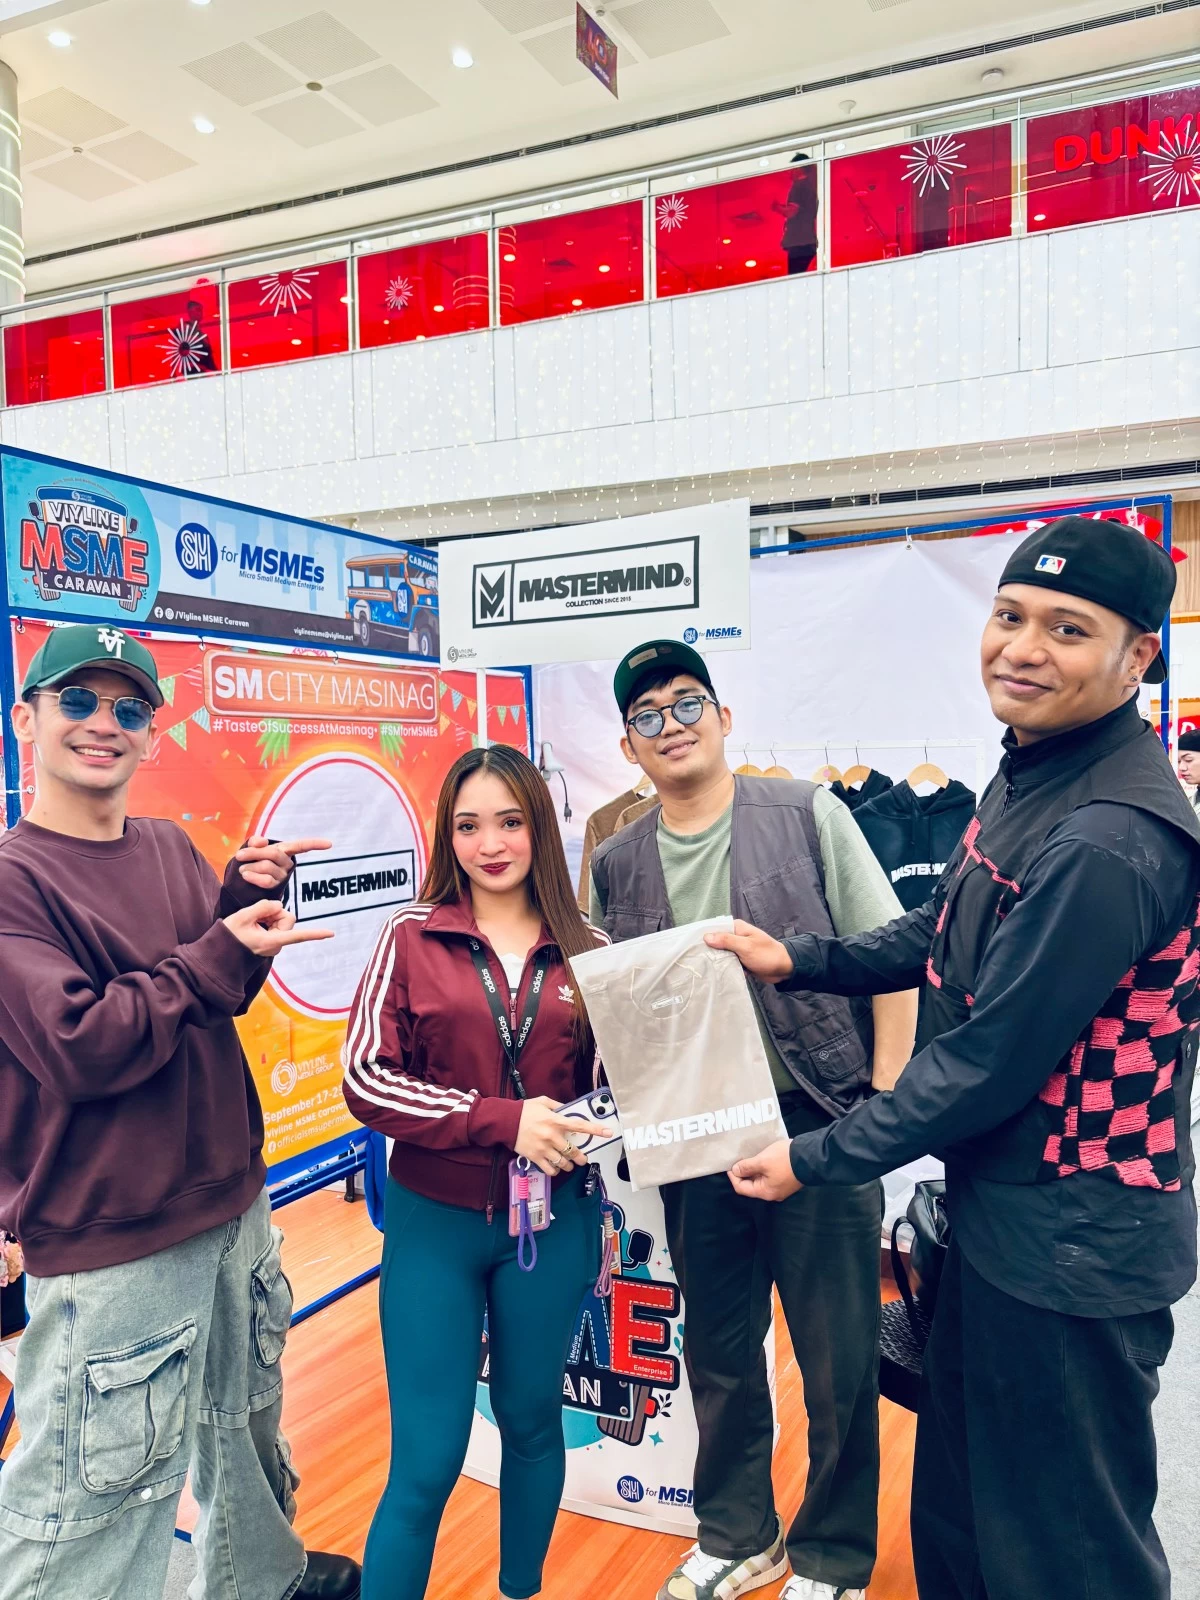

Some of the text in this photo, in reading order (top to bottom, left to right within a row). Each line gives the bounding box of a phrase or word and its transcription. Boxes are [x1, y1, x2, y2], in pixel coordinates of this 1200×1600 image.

[1054, 112, 1200, 173] DUNK
[49, 501, 120, 531] VIYLINE
[22, 519, 149, 586] MSME
[220, 545, 239, 563] for
[239, 542, 325, 584] MSMEs
[408, 554, 438, 574] CARAVAN
[53, 574, 121, 597] CARAVAN
[238, 570, 325, 592] Micro Small Medium Enterprise
[565, 598, 604, 608] COLLECTION
[202, 614, 224, 625] MSME
[224, 617, 250, 628] Caravan
[705, 626, 742, 638] MSMEs
[214, 665, 434, 710] SM CITY MASINAG
[380, 725, 438, 738] #SMforMSMEs
[890, 862, 948, 884] MASTERM
[481, 968, 496, 994] adidas
[532, 969, 544, 994] adidas
[498, 1015, 512, 1047] adidas
[517, 1016, 533, 1048] adidas
[263, 1097, 315, 1125] September
[295, 1112, 317, 1127] MSME
[623, 1097, 778, 1151] MASTERMIND
[633, 1364, 668, 1376] Enterprise
[562, 1372, 602, 1408] AN
[645, 1487, 658, 1497] for
